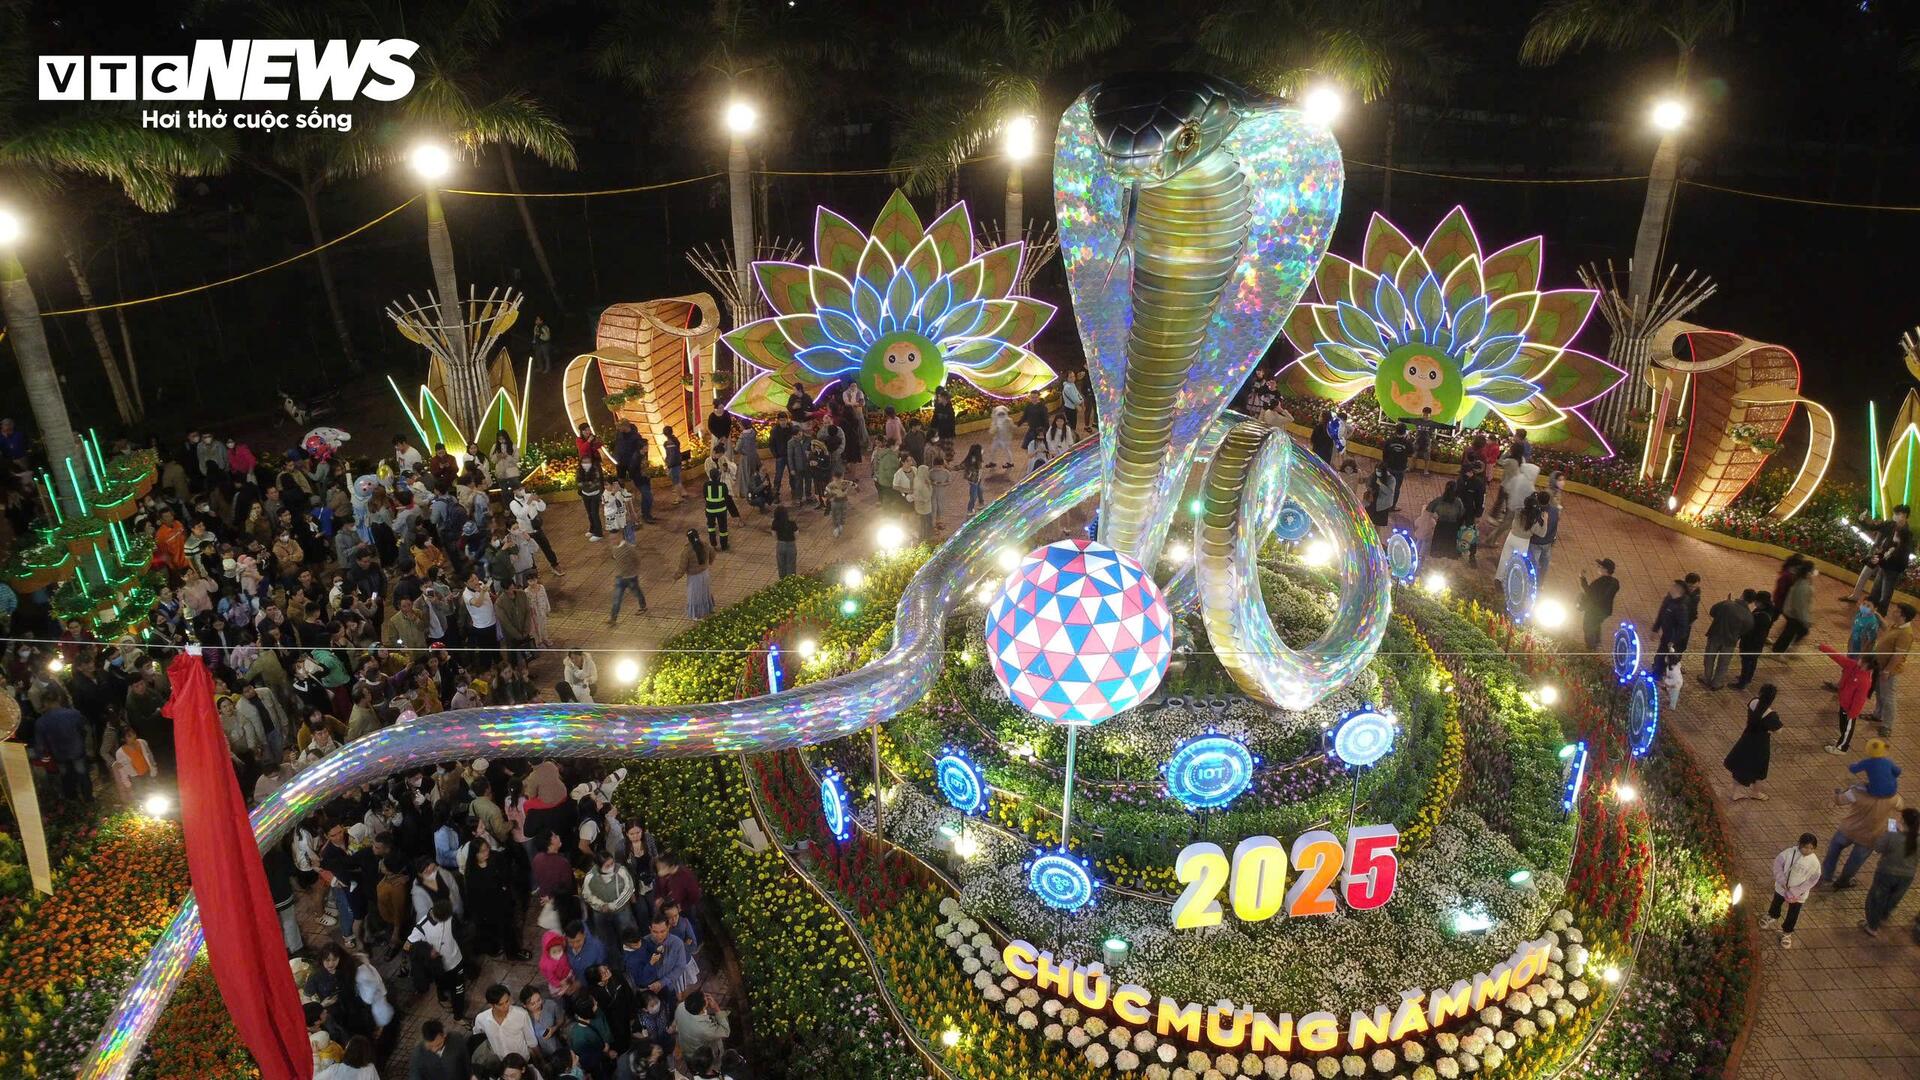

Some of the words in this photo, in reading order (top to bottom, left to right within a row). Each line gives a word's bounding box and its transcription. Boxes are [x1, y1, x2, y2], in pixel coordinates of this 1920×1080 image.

[1198, 766, 1226, 780] IOT
[1171, 823, 1400, 930] 2025
[1003, 940, 1152, 1025] CHÚC
[1157, 996, 1338, 1052] MỪNG
[1348, 979, 1472, 1050] NĂM
